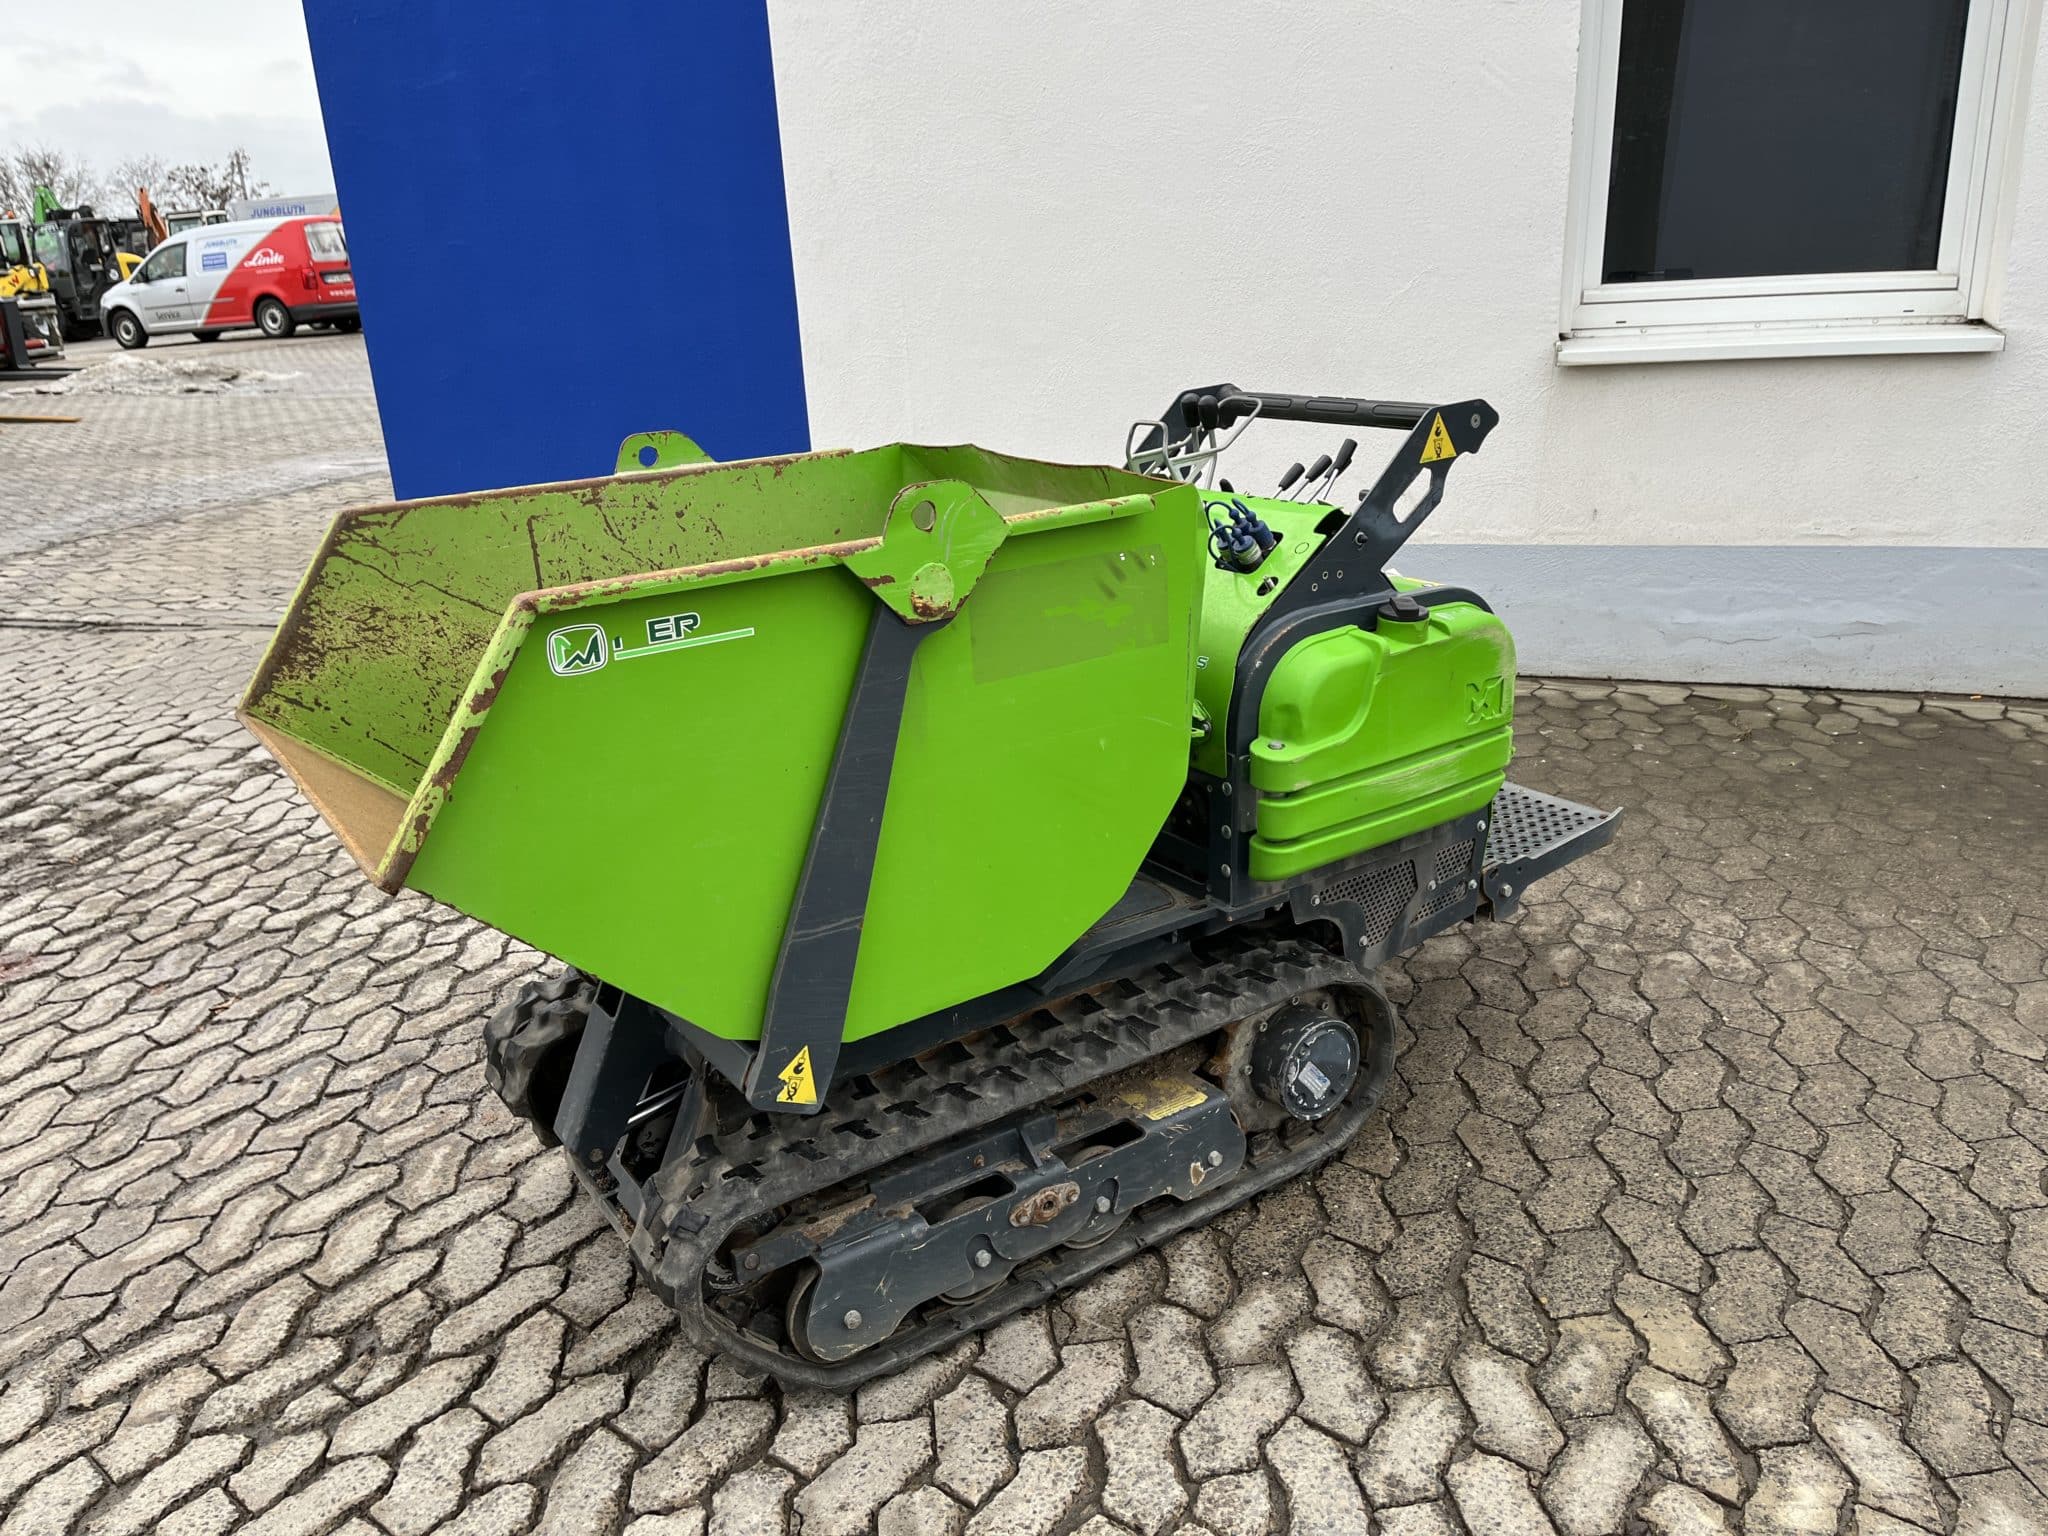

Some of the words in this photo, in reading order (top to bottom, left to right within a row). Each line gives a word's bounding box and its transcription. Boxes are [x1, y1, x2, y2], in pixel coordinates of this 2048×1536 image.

[250, 203, 306, 218] JUNGBLUTH
[243, 247, 285, 267] Linde
[155, 309, 181, 321] Service
